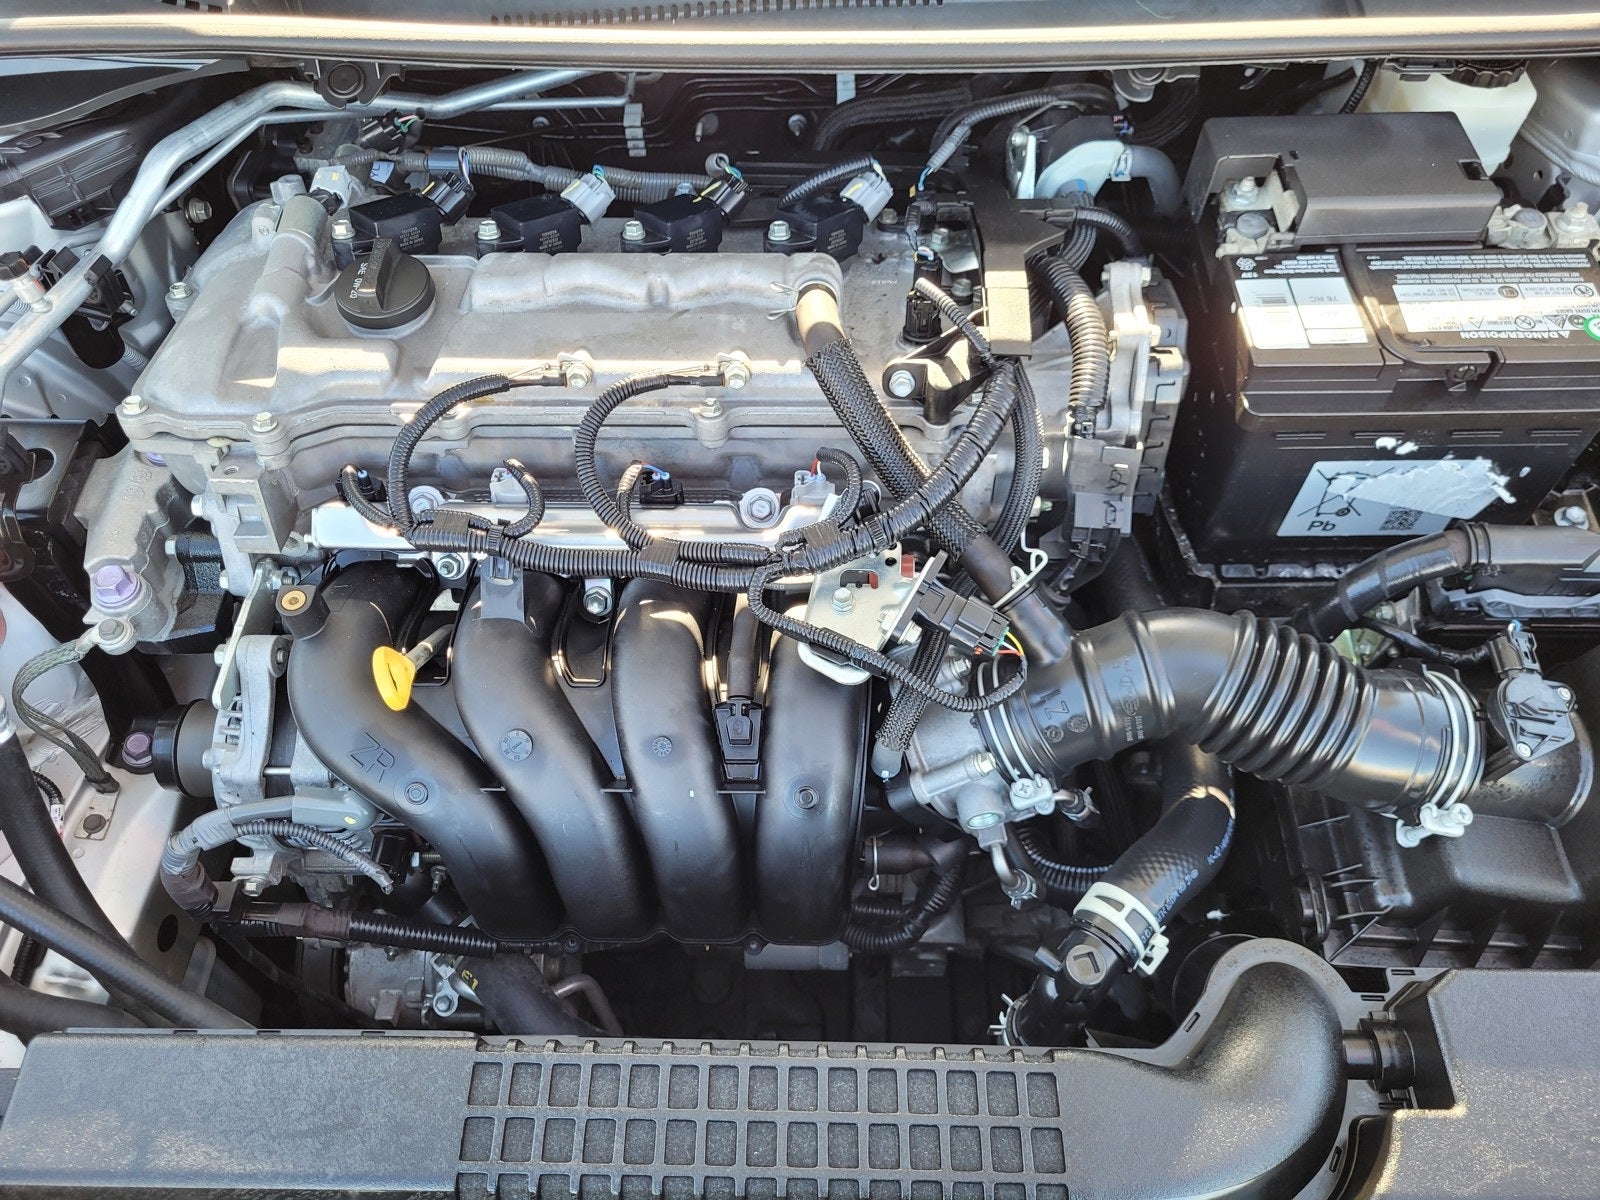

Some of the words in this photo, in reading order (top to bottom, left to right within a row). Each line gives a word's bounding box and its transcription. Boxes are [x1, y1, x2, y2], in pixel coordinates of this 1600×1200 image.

[357, 262, 369, 275] SAE
[349, 277, 364, 299] 0W-20
[1460, 331, 1559, 339] DANGER/POISON
[1307, 520, 1337, 532] Pb
[347, 731, 396, 784] ZR
